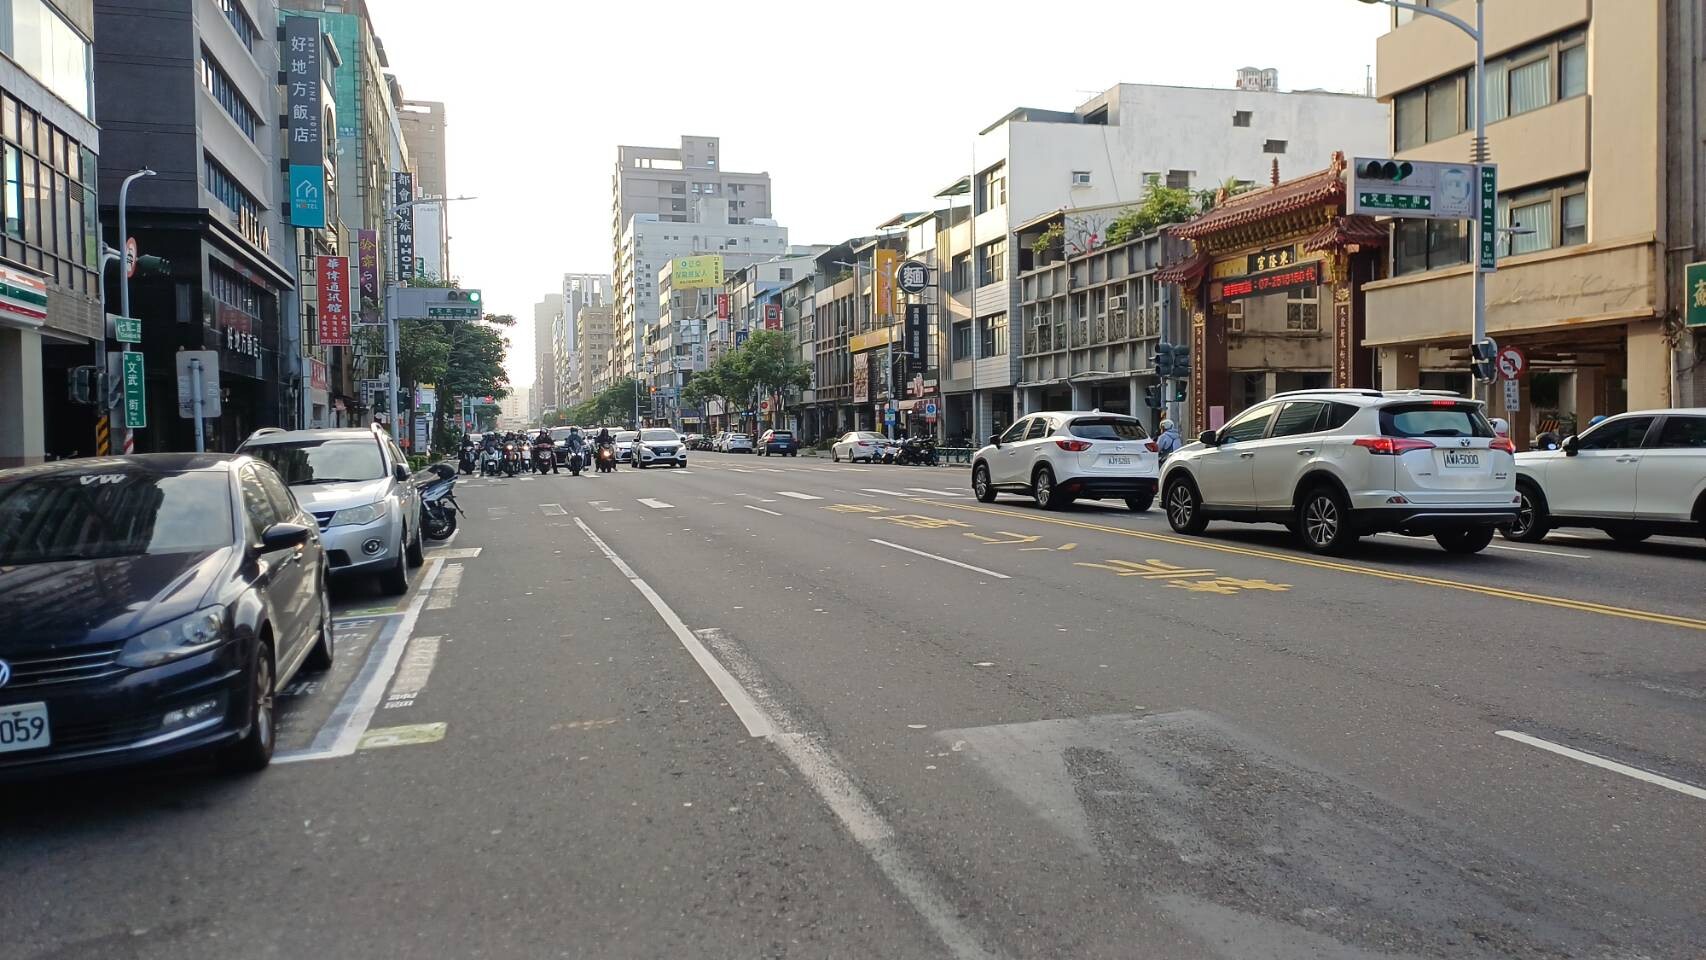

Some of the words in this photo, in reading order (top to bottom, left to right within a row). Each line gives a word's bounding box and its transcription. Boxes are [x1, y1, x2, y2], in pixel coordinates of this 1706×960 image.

[291, 36, 309, 143] 好地方飯店
[1484, 182, 1492, 242] 七賢二路
[903, 266, 924, 288] 麵
[127, 361, 139, 411] 文武一街
